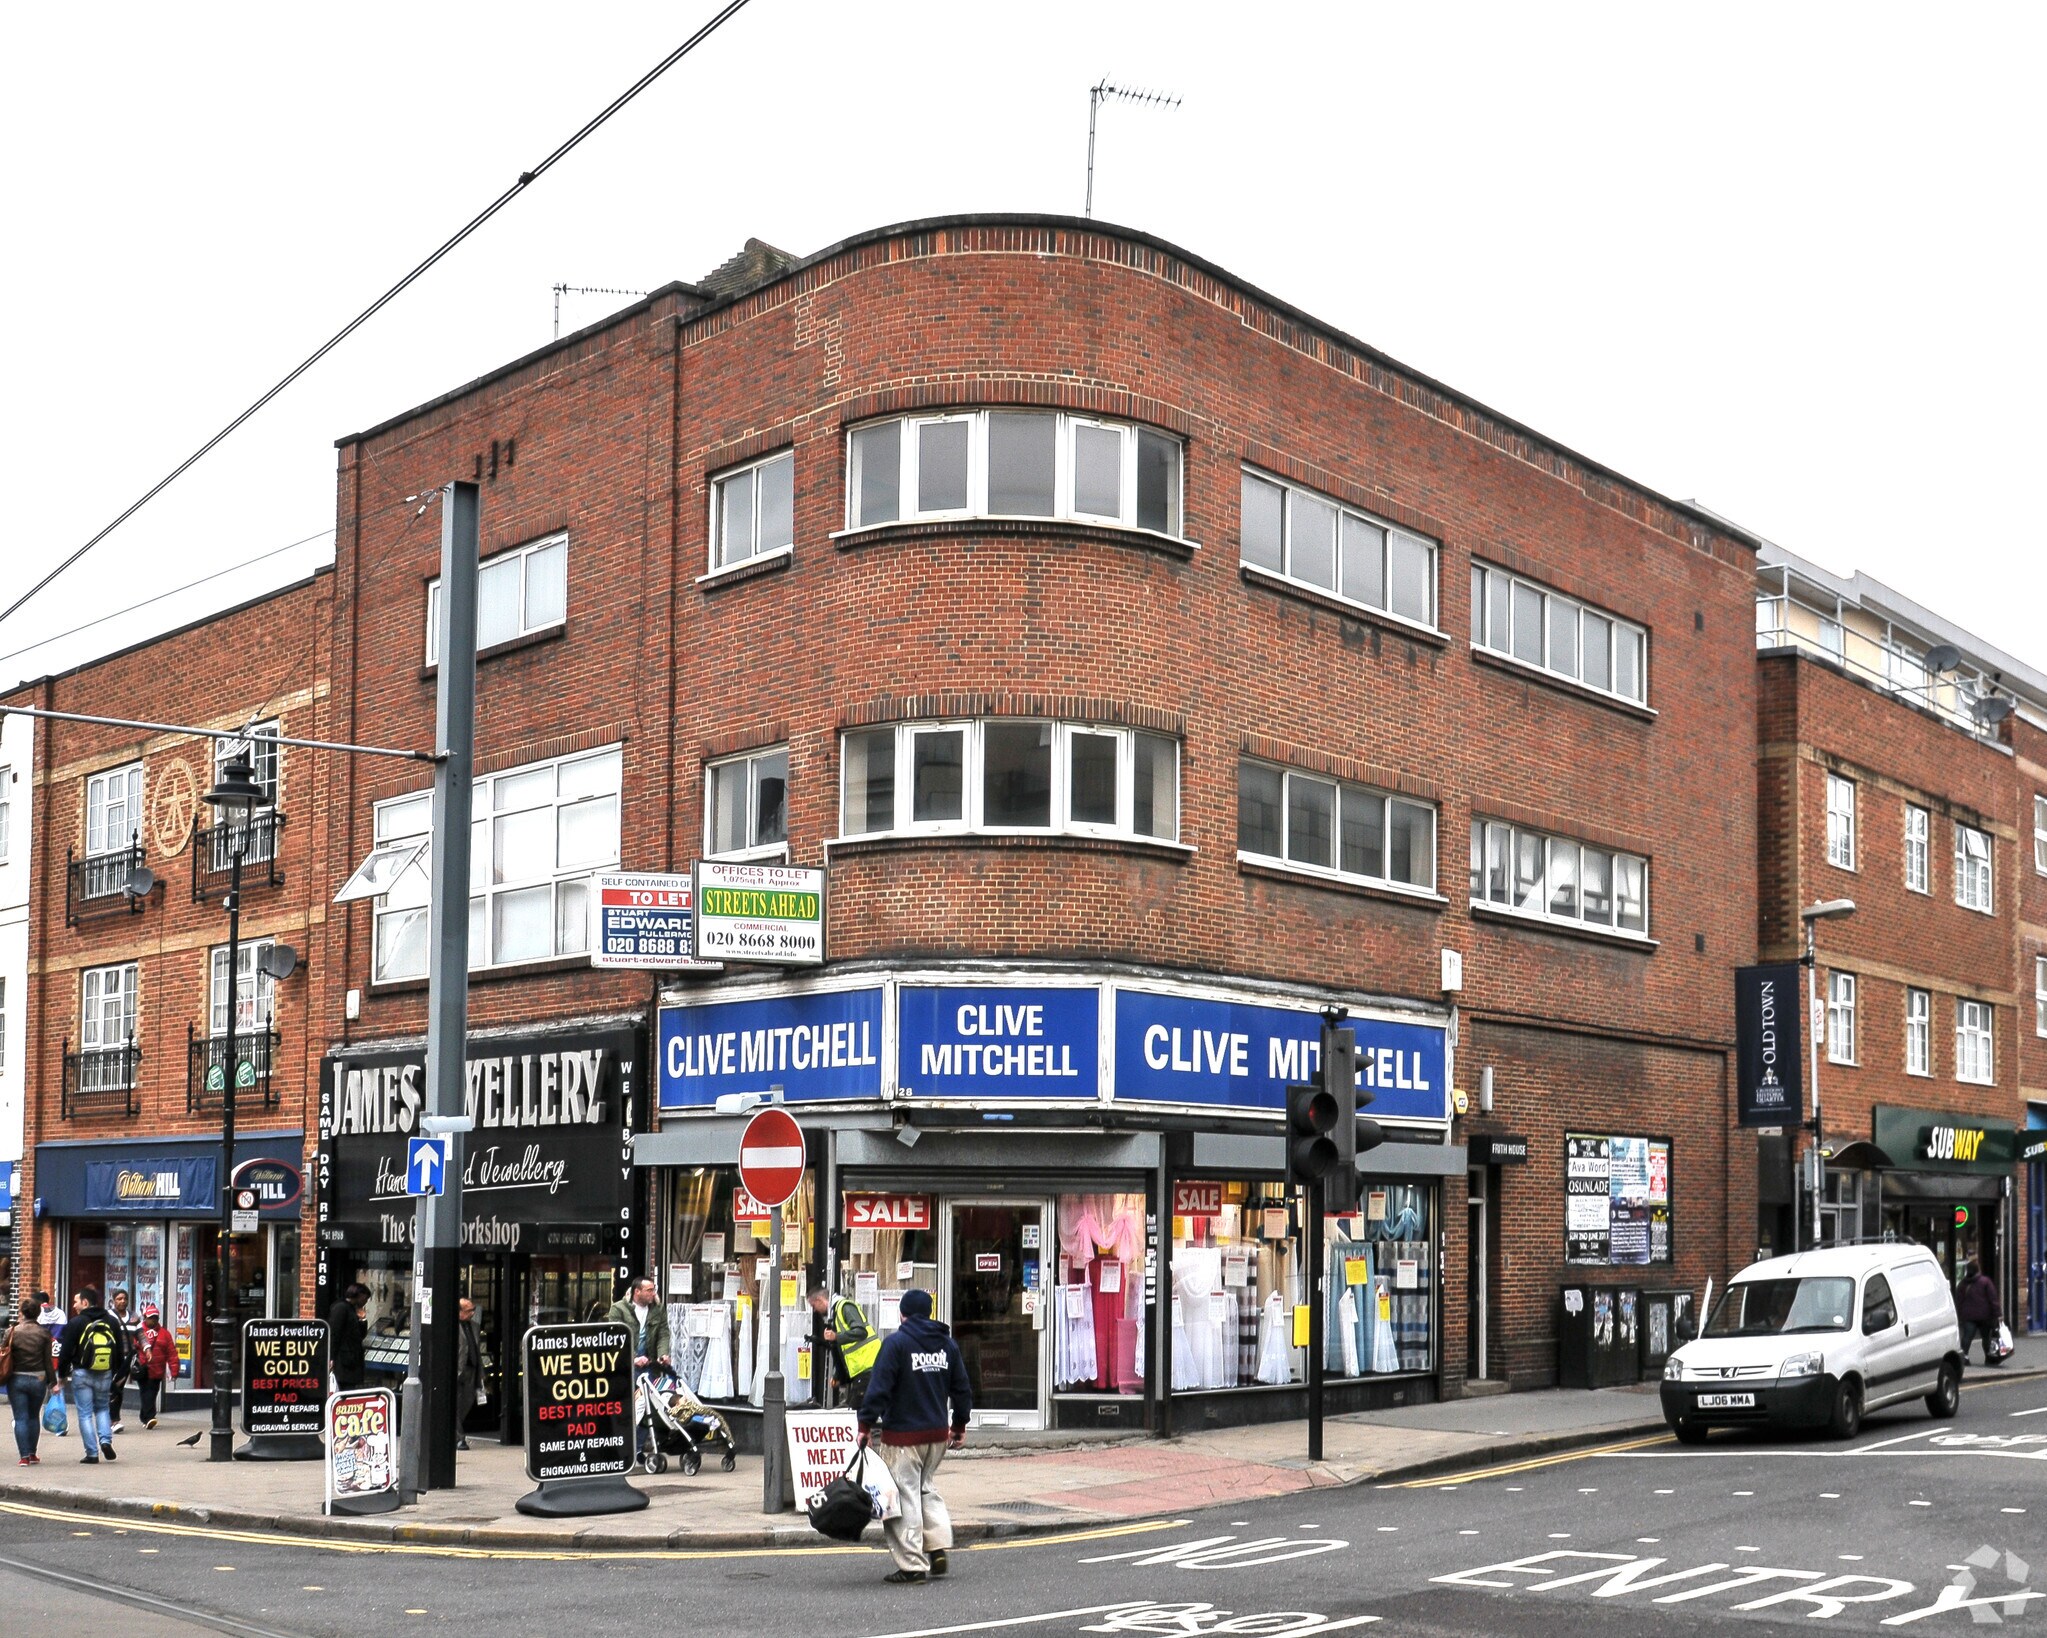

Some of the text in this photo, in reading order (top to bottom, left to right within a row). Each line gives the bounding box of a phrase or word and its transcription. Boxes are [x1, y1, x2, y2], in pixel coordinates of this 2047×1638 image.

[712, 865, 810, 879] OFFICES TO LET
[601, 877, 622, 886] SELF
[625, 878, 678, 888] CONTAINED
[768, 878, 800, 887] Approx
[629, 891, 689, 906] TO LET
[706, 889, 816, 919] STREETS AHEAD
[734, 922, 788, 932] COMMERCIAL
[607, 937, 634, 953] 020
[638, 938, 675, 954] 8688
[707, 931, 815, 950] 020 8668 8000
[957, 1004, 1043, 1036] CLIVE
[1761, 981, 1776, 1064] OLD TOWN
[667, 1021, 876, 1079] CLIVE MITCHELL
[1144, 1024, 1430, 1091] CLIVE MITHELL
[921, 1044, 1078, 1076] MITCHELL
[331, 1049, 606, 1137] JAMES WELLERY
[899, 1087, 913, 1096] 28
[320, 1093, 331, 1140] SAME
[1927, 1126, 1984, 1161] SUBWAY
[2023, 1140, 2047, 1159] SUB
[250, 1168, 286, 1182] William
[320, 1154, 330, 1189] DAY
[481, 1144, 566, 1194] Jewellery
[619, 1061, 632, 1279] WE BUY GOLD
[117, 1169, 181, 1198] William HILL
[1568, 1180, 1609, 1194] OSUNLADE
[1178, 1187, 1219, 1212] SALE
[853, 1199, 924, 1223] SALE
[380, 1212, 405, 1244] The
[460, 1214, 521, 1253] orkshop
[249, 1325, 325, 1340] James Jewellery
[531, 1331, 627, 1351] James Jewellery
[255, 1340, 319, 1357] WE BUY
[264, 1360, 310, 1376] GOLD
[540, 1351, 620, 1377] WE BUY
[252, 1378, 319, 1390] BEST PRICES
[552, 1377, 609, 1401] GOLD
[274, 1392, 298, 1403] PAID
[1701, 1395, 1751, 1406] LJ06 MMA
[252, 1404, 320, 1414] SAME DAY REPAIRS
[282, 1414, 289, 1423] &
[539, 1401, 623, 1420] BEST PRICES
[251, 1422, 319, 1432] ENGRAVING SERVICE
[334, 1408, 385, 1439] cafe
[567, 1421, 597, 1437] PAID
[792, 1426, 854, 1443] TUCKERS
[539, 1436, 624, 1453] SAME DAY REPAIRS
[579, 1451, 587, 1462] &
[807, 1448, 846, 1466] MEAT
[540, 1460, 624, 1477] ENGRAVING SERVICE
[1078, 1535, 1350, 1570] NO
[1428, 1549, 2047, 1626] ENTRY
